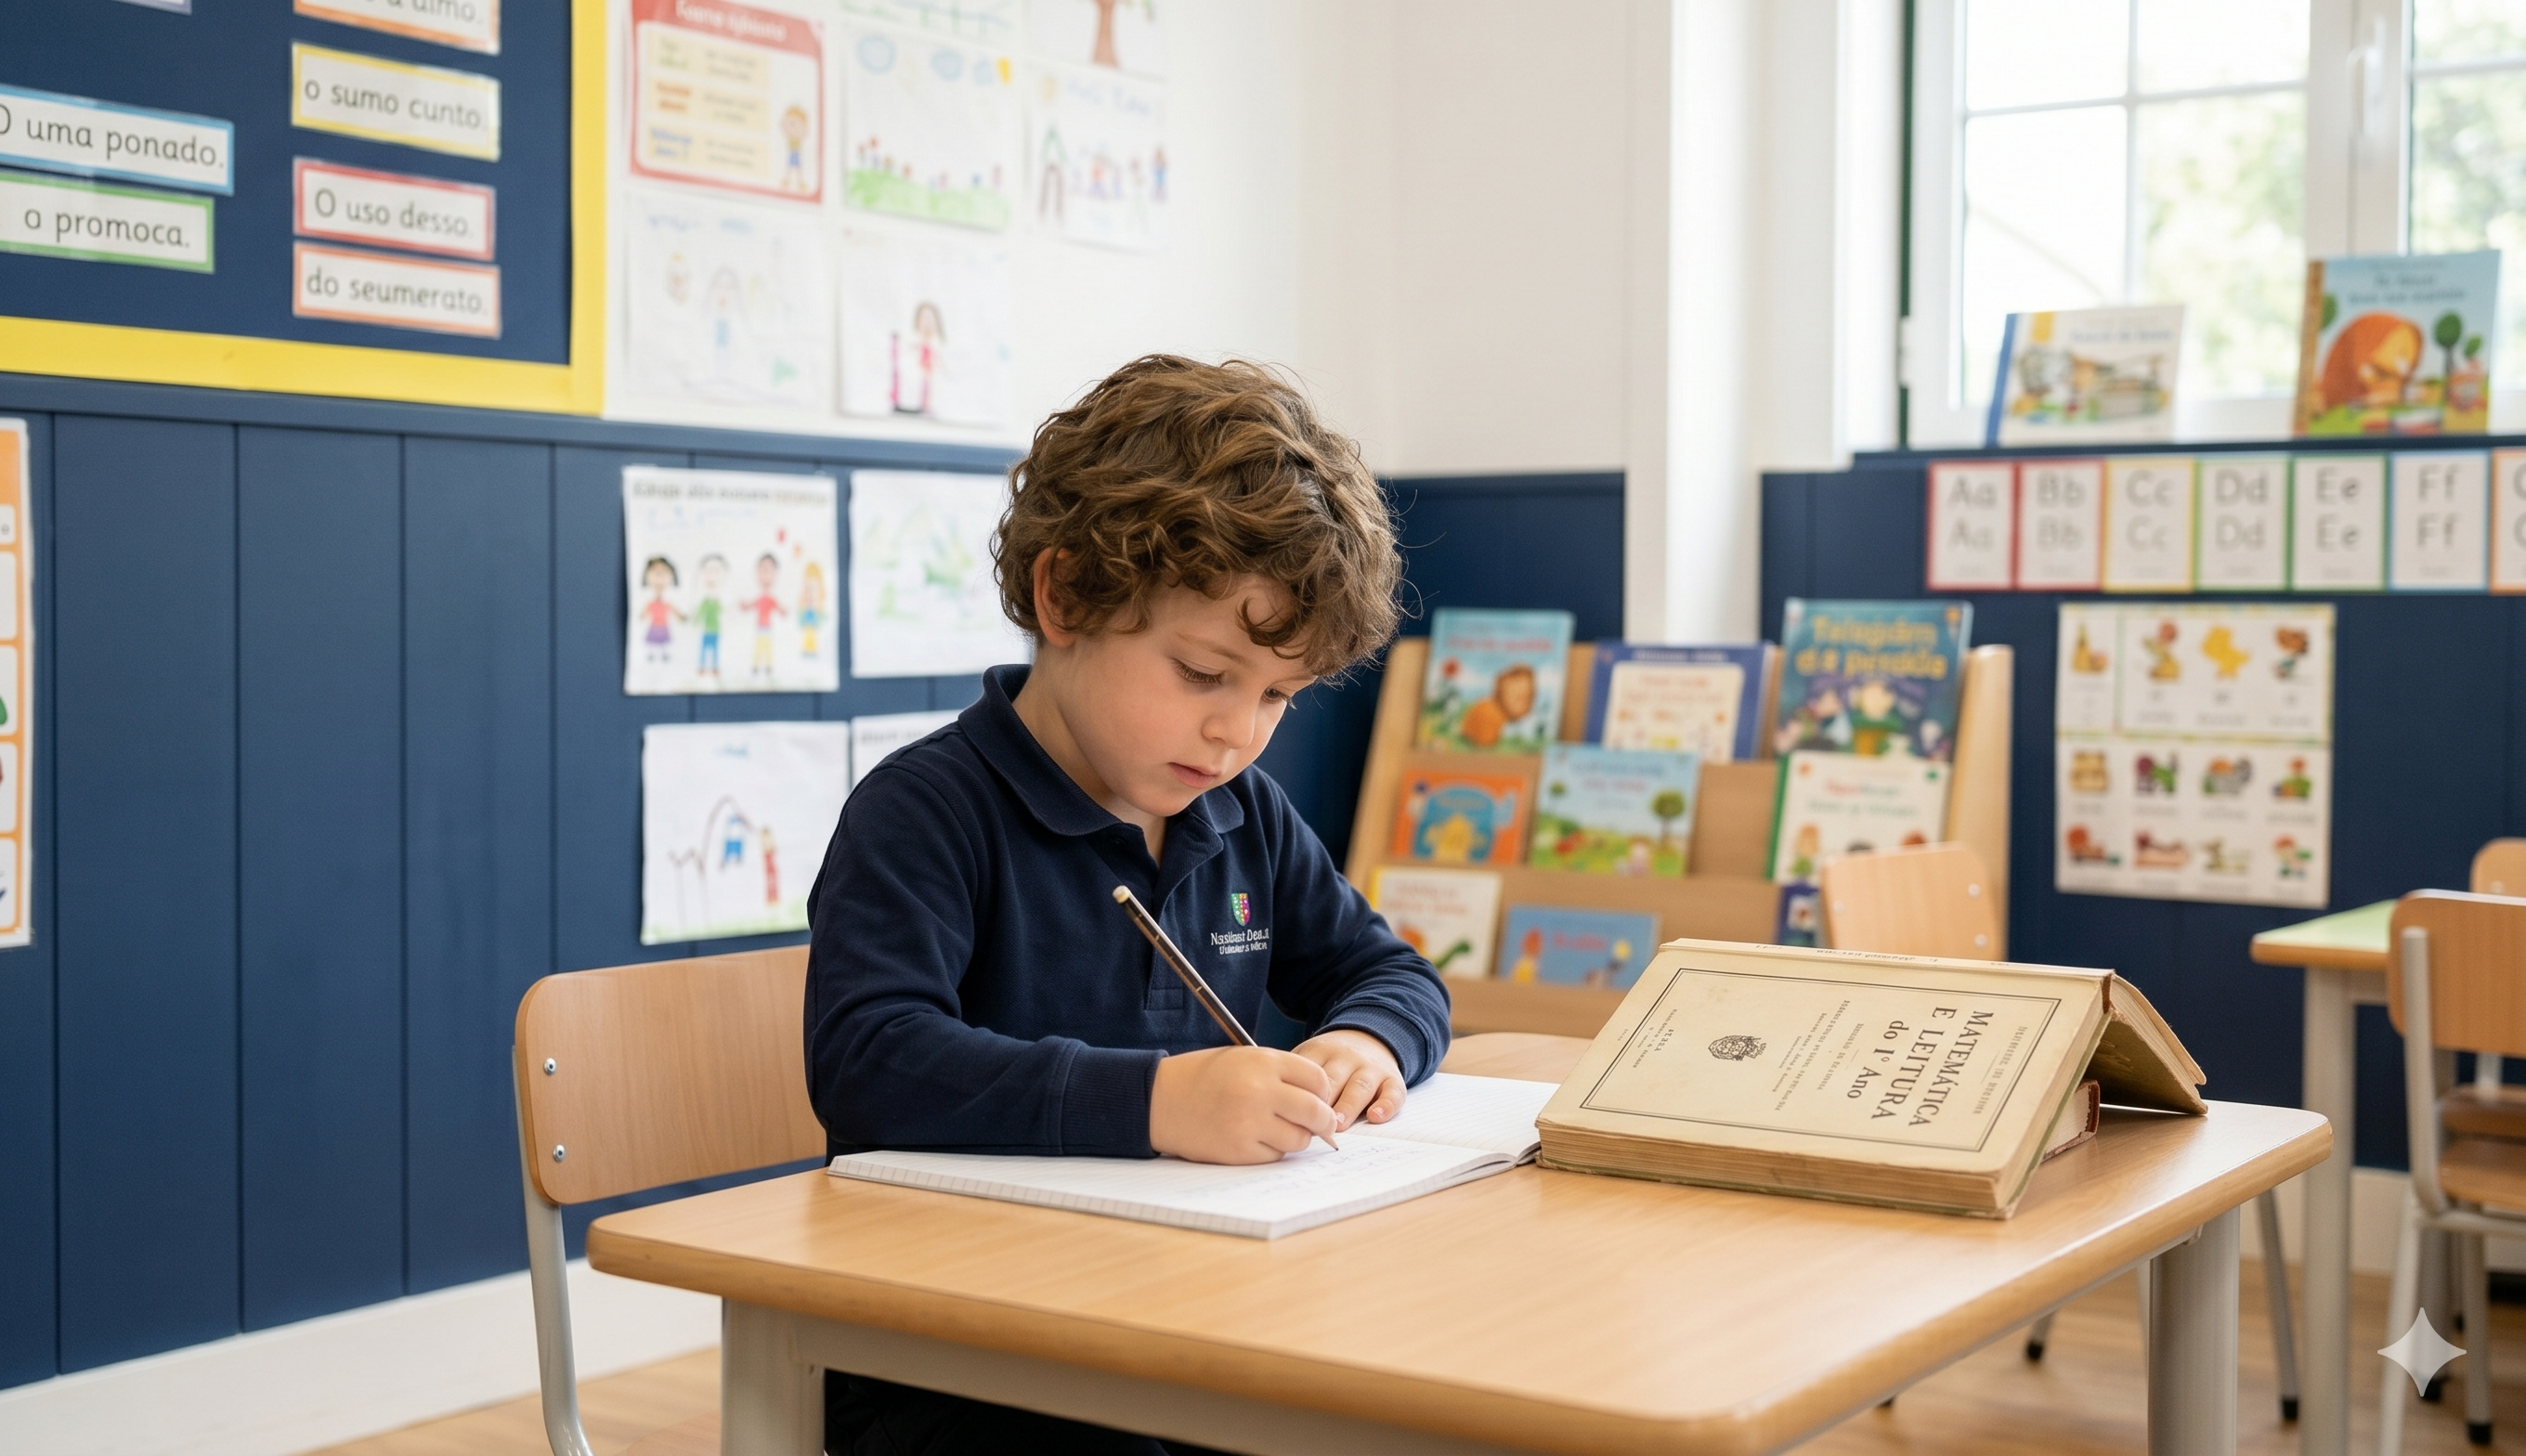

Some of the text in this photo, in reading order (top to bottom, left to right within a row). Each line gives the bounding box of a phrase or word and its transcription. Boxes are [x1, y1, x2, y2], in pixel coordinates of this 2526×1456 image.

[330, 84, 399, 115] sumo
[27, 118, 94, 149] uma
[106, 129, 225, 169] ponado.
[314, 188, 337, 219] O
[346, 201, 391, 227] uso
[56, 211, 189, 249] promoca.
[306, 266, 340, 298] do
[1947, 474, 1996, 510] Aa
[2036, 471, 2086, 508] Bb
[2126, 468, 2174, 508] Cc
[2215, 468, 2269, 507] Dd
[2315, 466, 2361, 506] Ee
[2417, 463, 2461, 503] Ff
[1883, 1020, 1909, 1040] do
[1847, 1066, 1882, 1098] Ano
[1870, 1007, 1958, 1120] E LEITURA
[1908, 1010, 1995, 1126] MATEMÁTICA
